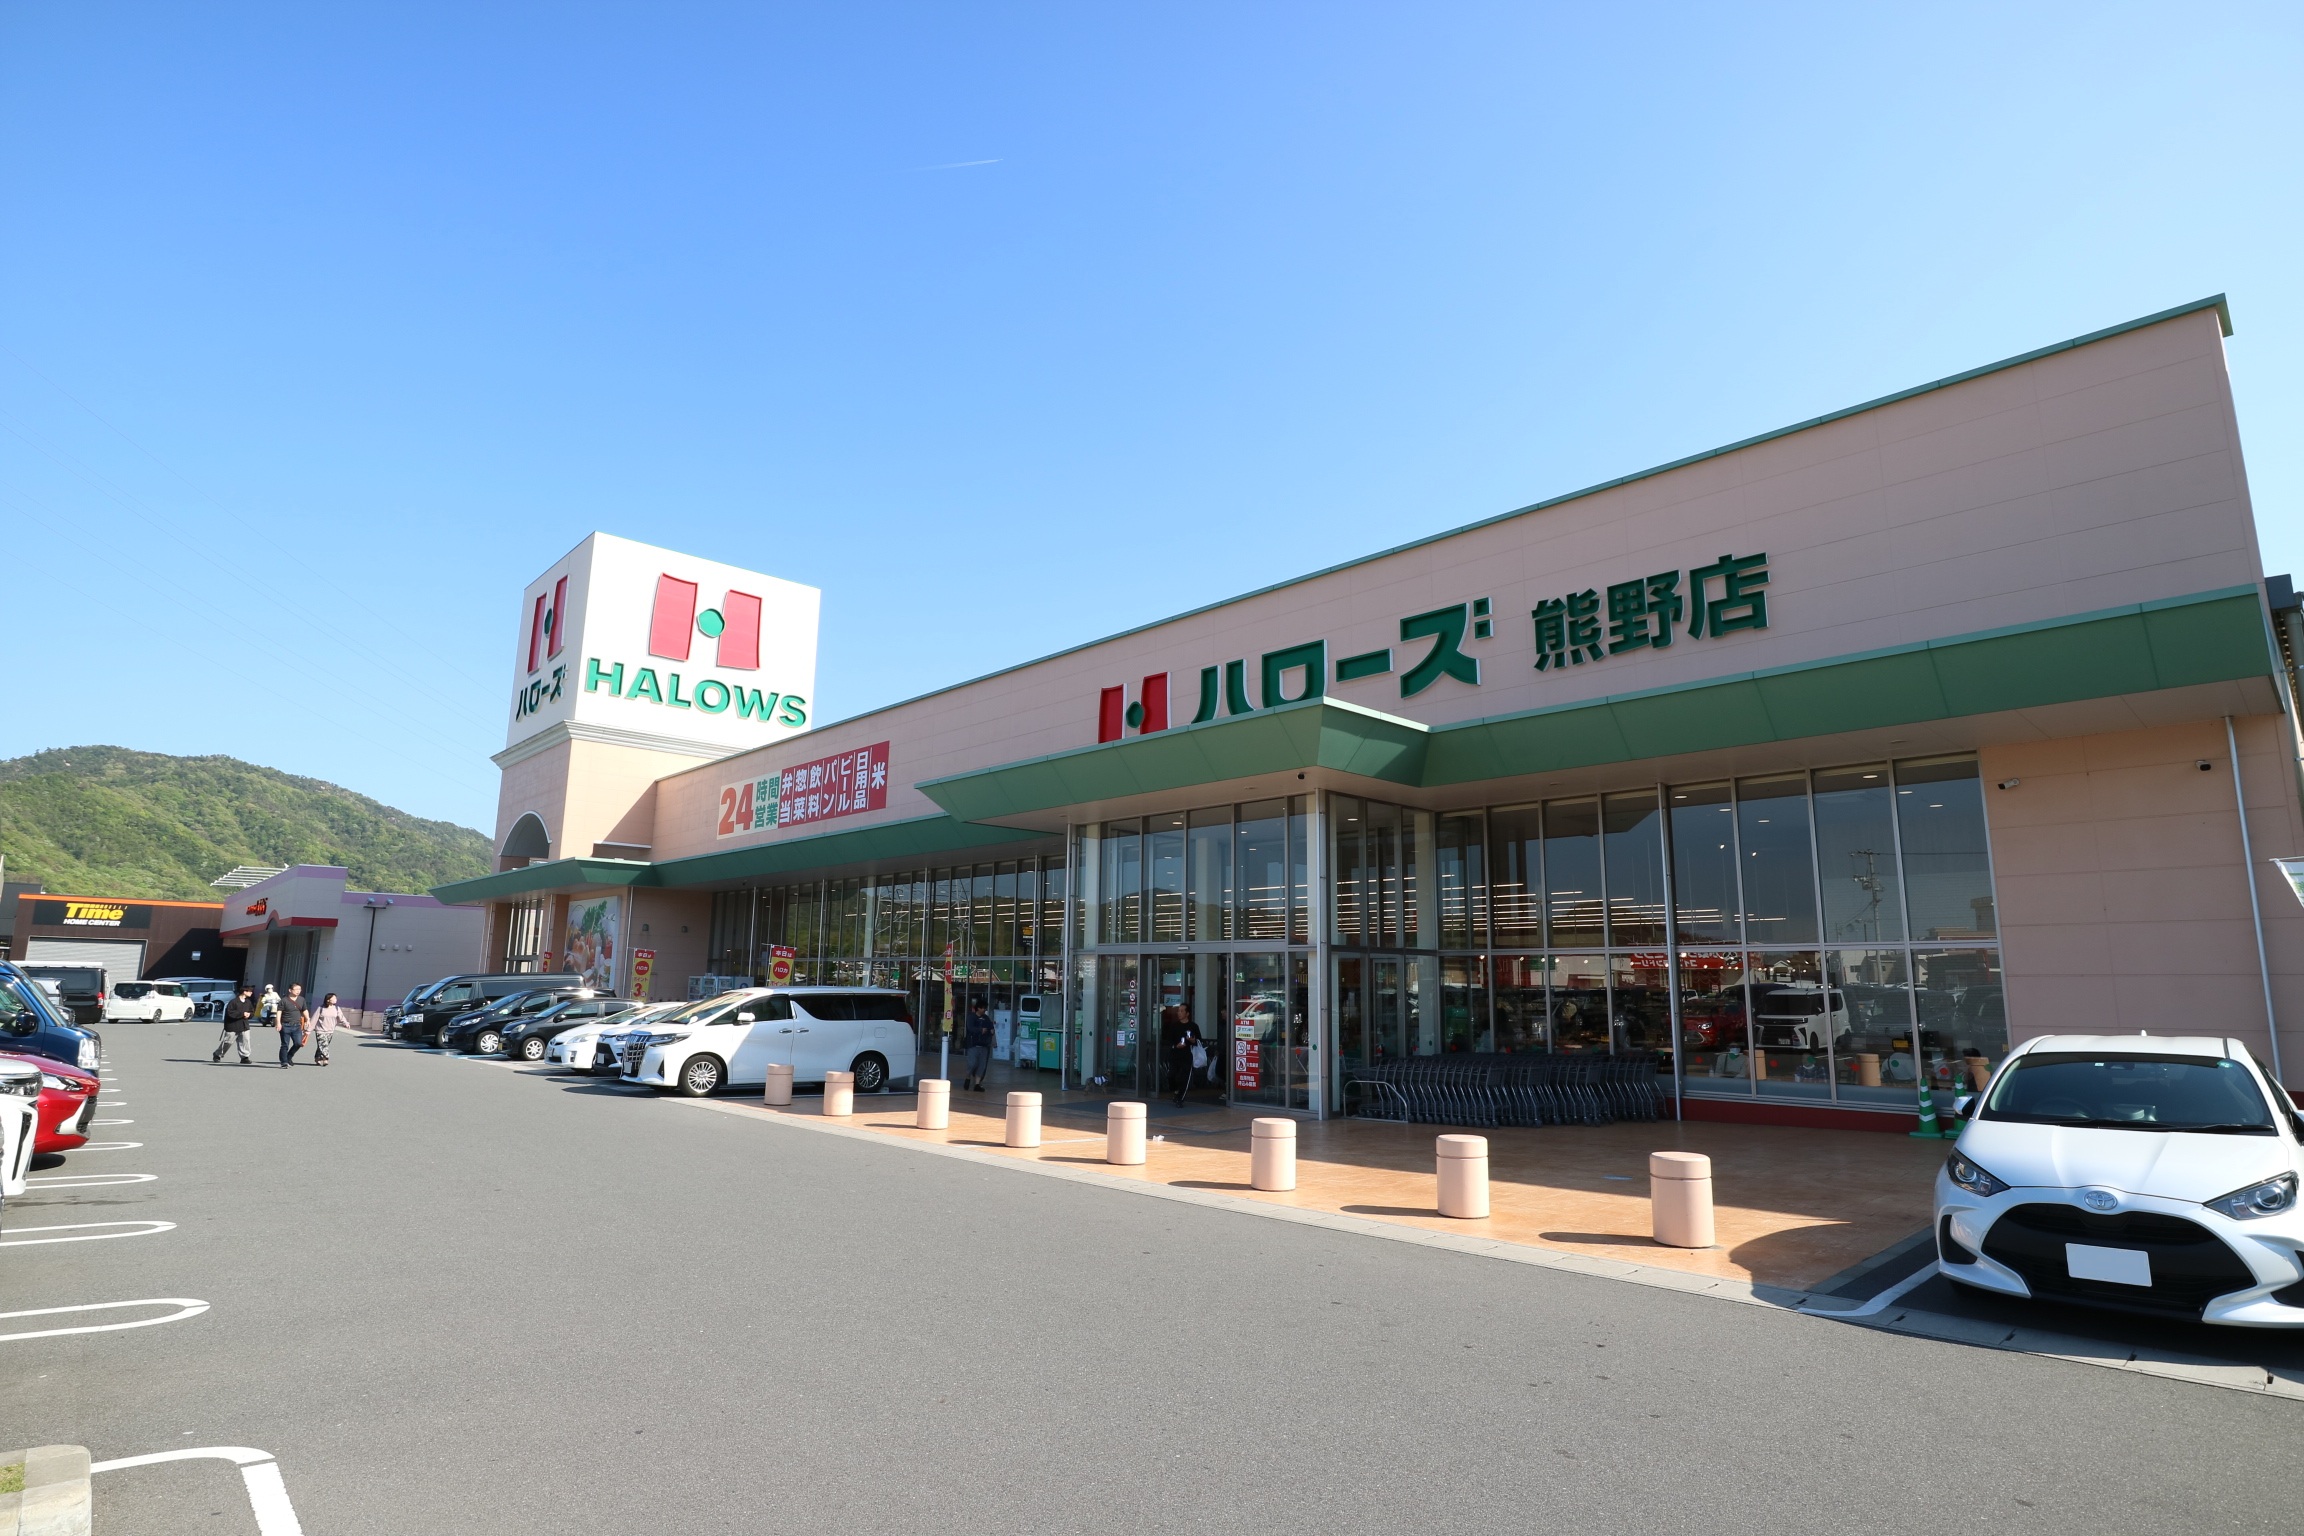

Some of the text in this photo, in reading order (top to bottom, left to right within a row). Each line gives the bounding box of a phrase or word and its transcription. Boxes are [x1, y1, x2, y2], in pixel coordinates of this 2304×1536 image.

[1191, 597, 1494, 724] ハローズ
[1531, 552, 1771, 673] 熊野店
[515, 662, 569, 723] ハローズ
[584, 657, 807, 728] HALOWS
[755, 776, 780, 803] 時間
[779, 773, 793, 824] 弁当
[793, 769, 808, 822] 惣菜
[808, 765, 822, 818] 飲料
[823, 760, 838, 815] パン
[838, 755, 853, 812] ビール
[853, 751, 868, 810] 日用品
[871, 762, 886, 790] 米
[718, 783, 754, 835] 24
[754, 802, 779, 828] 営業
[63, 918, 121, 927] HOME CENTER
[65, 902, 124, 920] Time
